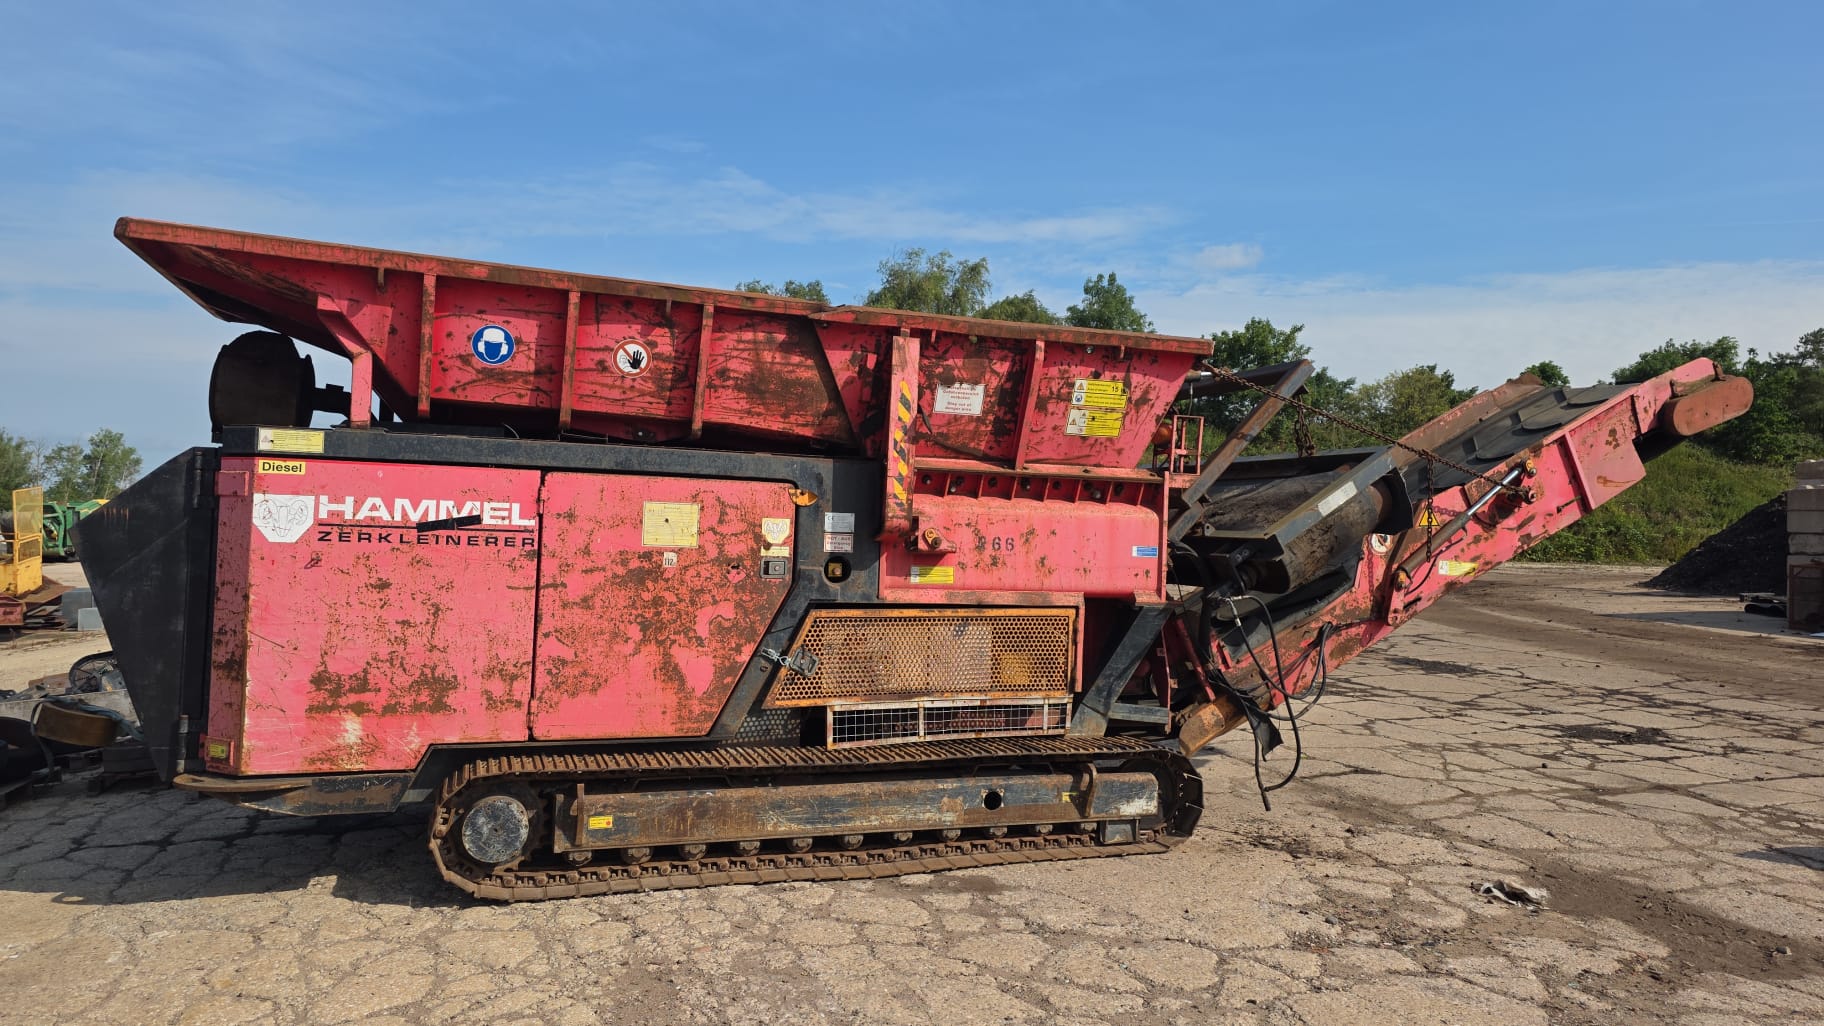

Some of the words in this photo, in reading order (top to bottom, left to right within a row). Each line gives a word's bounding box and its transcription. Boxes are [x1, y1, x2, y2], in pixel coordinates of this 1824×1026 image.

[262, 462, 302, 473] Diesel
[318, 495, 536, 526] HAMMEL
[317, 531, 535, 548] ZERKLEINERER
